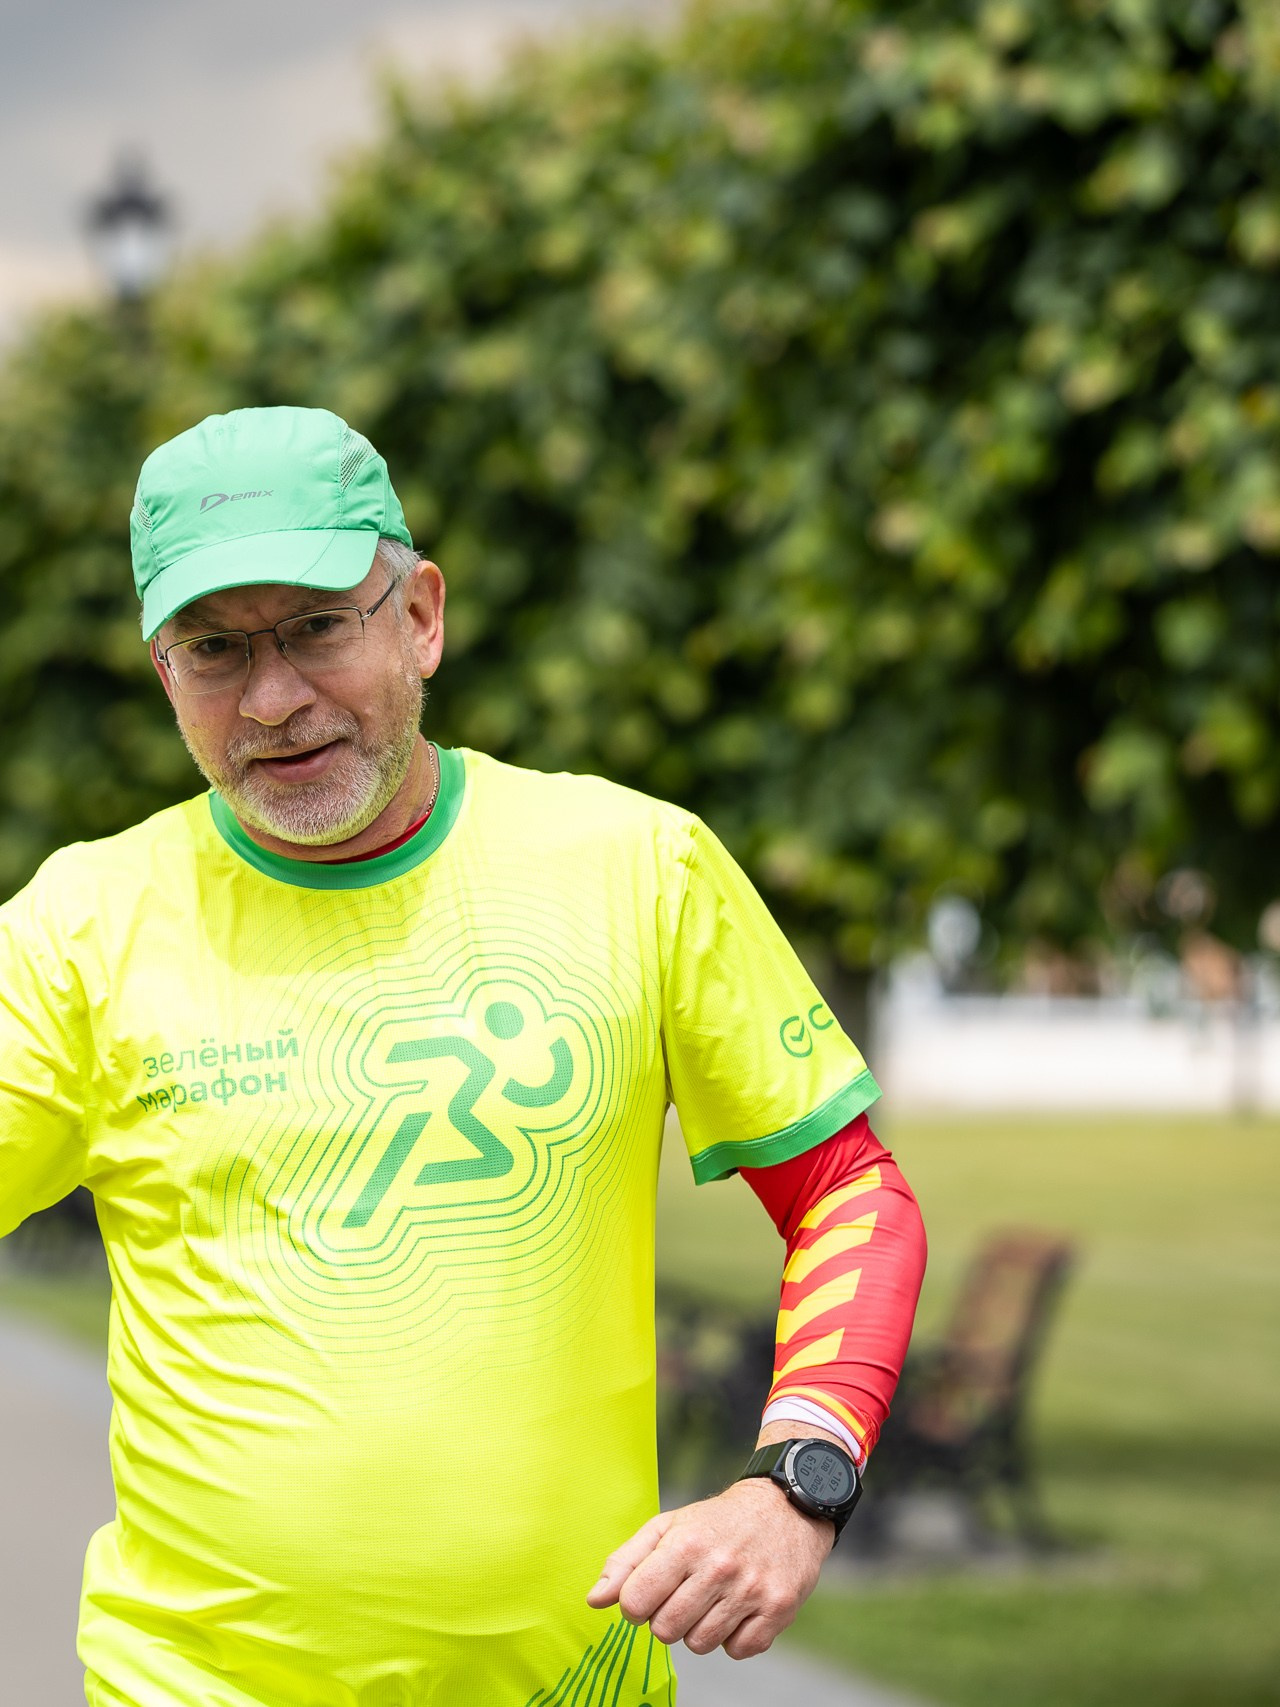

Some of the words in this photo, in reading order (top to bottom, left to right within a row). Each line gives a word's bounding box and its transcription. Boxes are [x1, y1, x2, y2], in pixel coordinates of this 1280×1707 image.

[143, 1028, 299, 1078] зелёный
[136, 1068, 287, 1113] марафон
[800, 1454, 817, 1477] 6:10
[829, 1475, 841, 1492] 167
